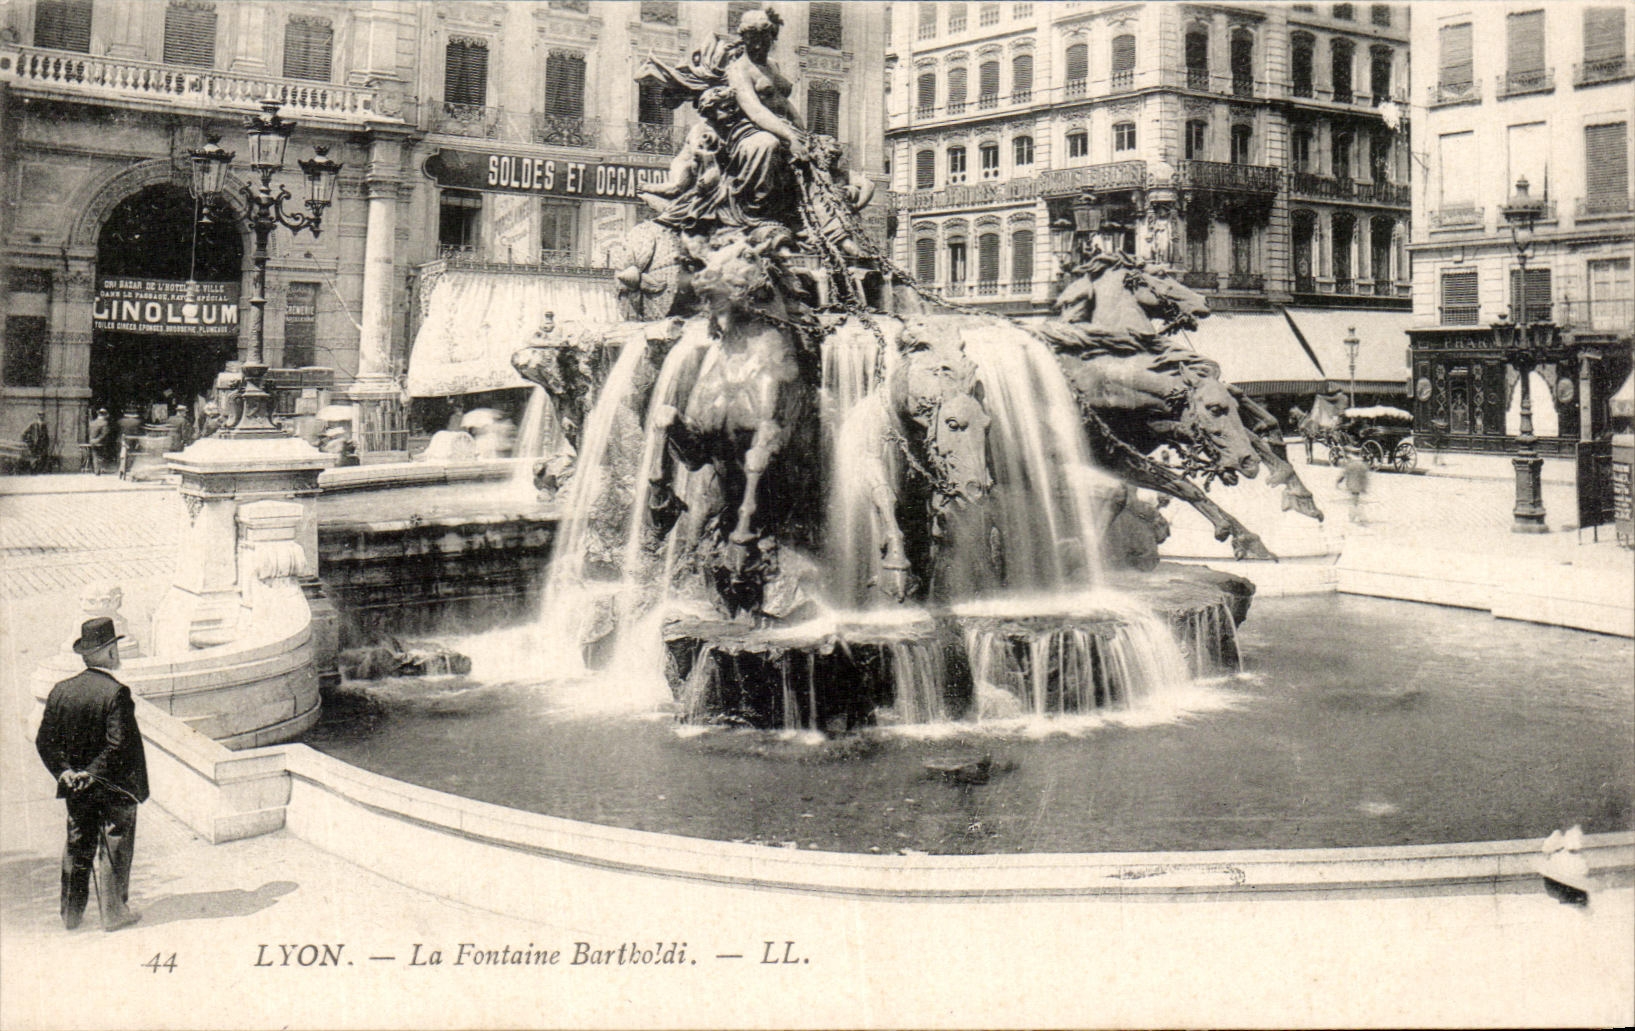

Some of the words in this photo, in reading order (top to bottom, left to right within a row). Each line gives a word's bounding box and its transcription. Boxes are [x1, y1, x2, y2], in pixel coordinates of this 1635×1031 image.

[488, 155, 556, 191] SOLDES
[566, 162, 586, 194] ET
[119, 281, 143, 291] BAZAR
[145, 282, 156, 291] DE
[203, 284, 225, 293] VILLE
[100, 290, 120, 298] DANS
